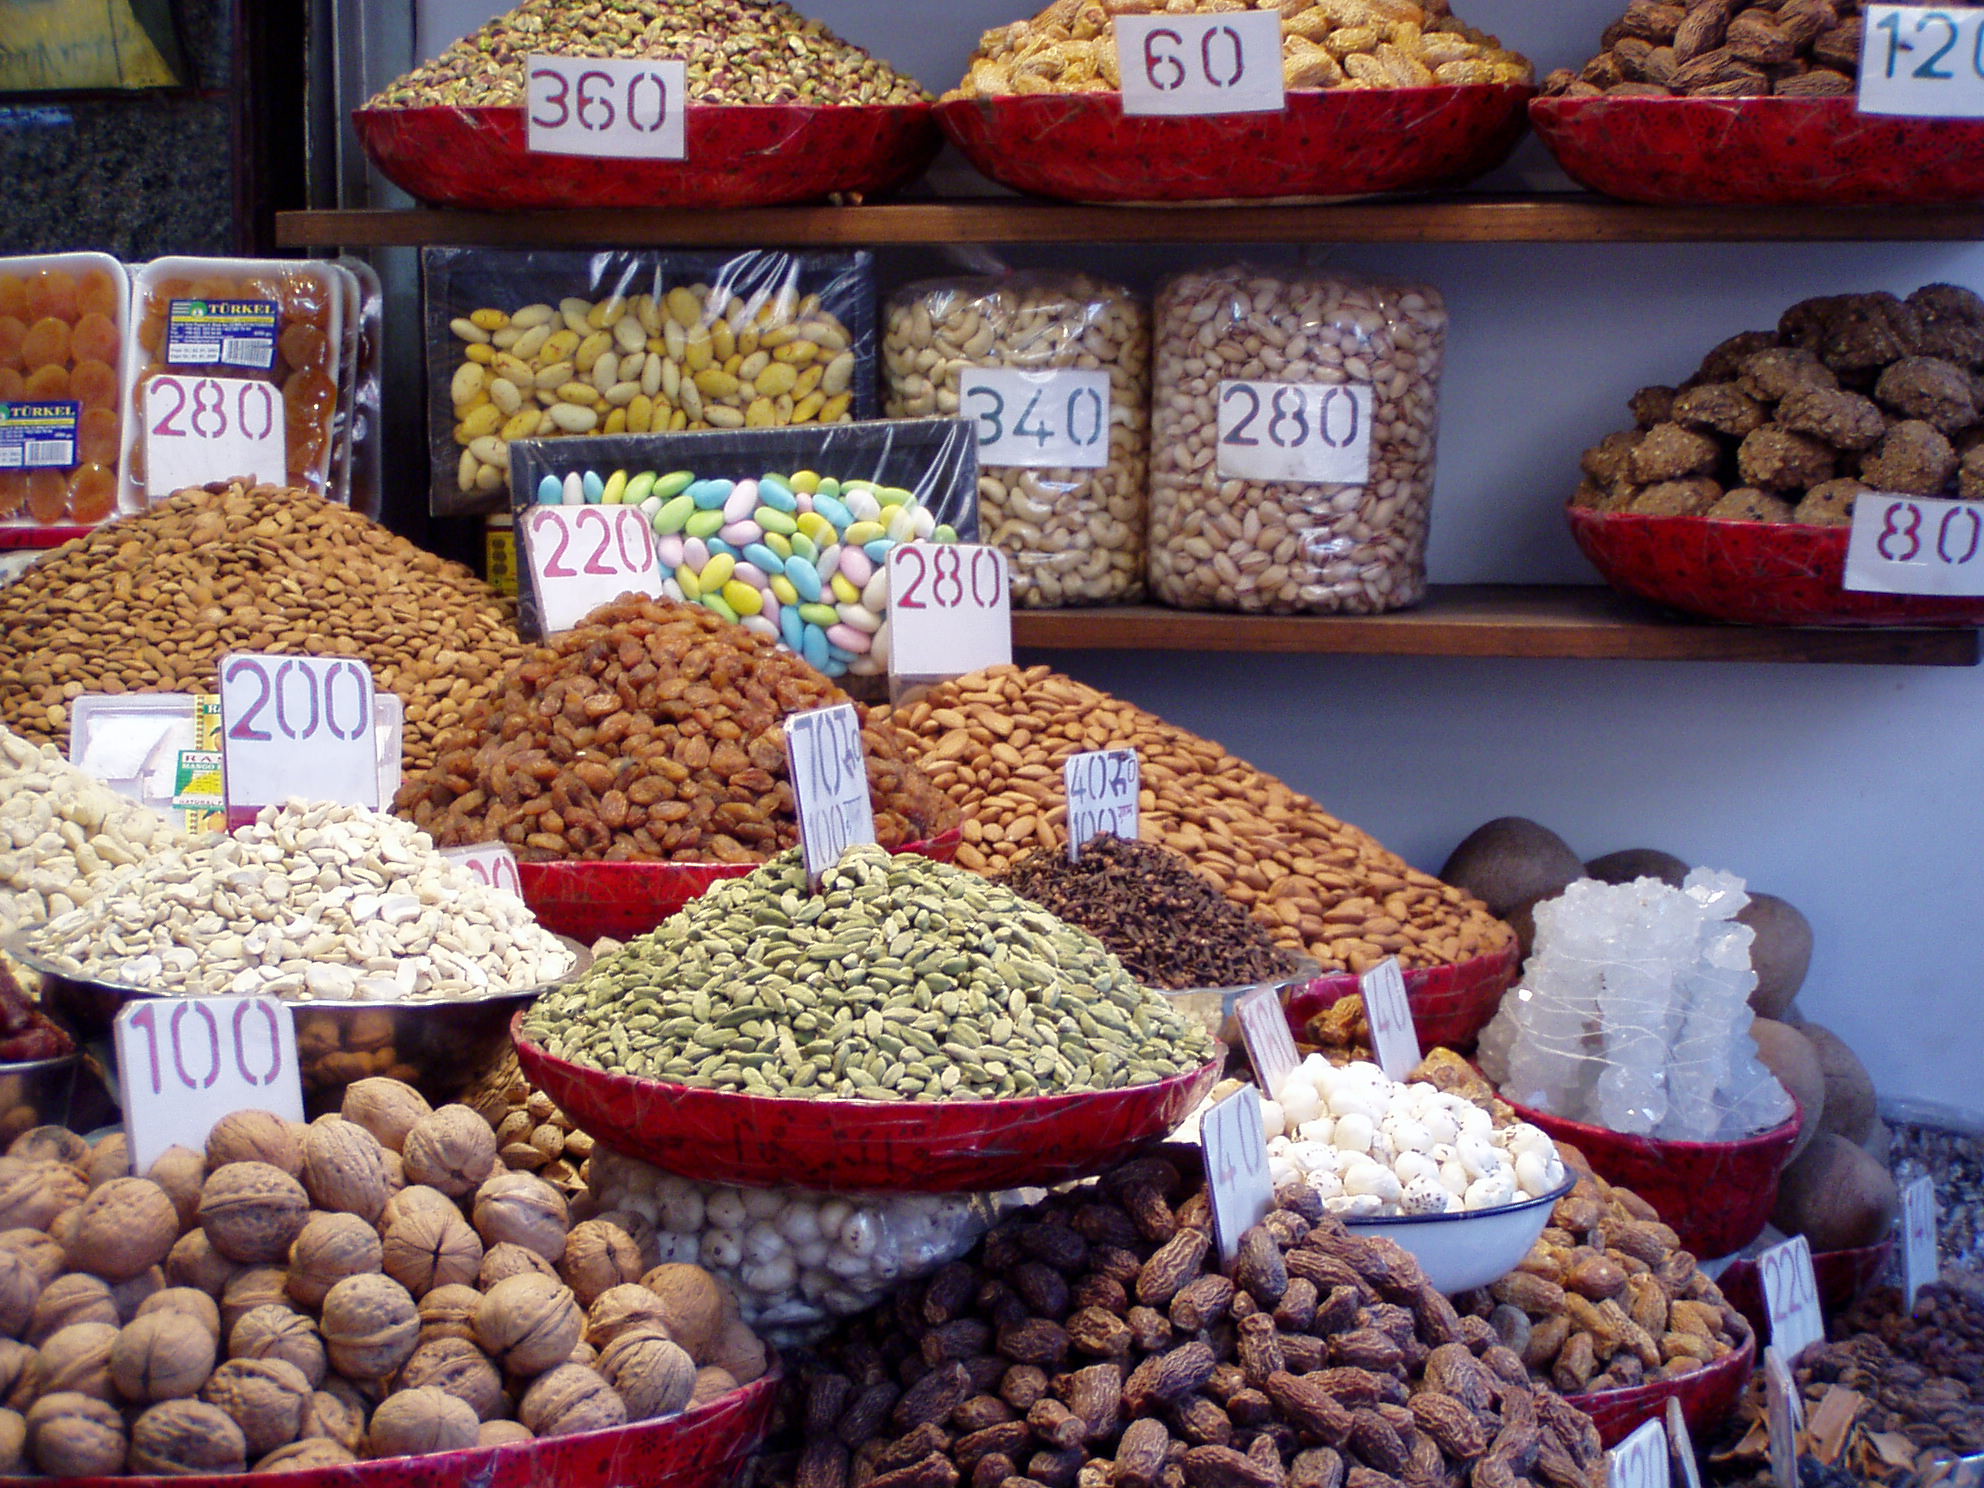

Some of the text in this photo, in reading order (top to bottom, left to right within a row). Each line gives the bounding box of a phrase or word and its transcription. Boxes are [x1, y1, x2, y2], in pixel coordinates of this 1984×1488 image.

[1144, 26, 1244, 90] 60
[1877, 11, 1984, 79] 12
[531, 69, 667, 132] 360
[208, 302, 275, 314] TÜRKEL
[10, 405, 76, 416] TÜRKEL
[150, 377, 272, 439] 280
[966, 385, 1102, 448] 340
[1222, 383, 1359, 448] 280
[533, 508, 655, 578] 220
[1877, 502, 1983, 565] 80
[895, 545, 1000, 609] 280
[226, 659, 367, 740] 200
[1070, 754, 1107, 805] 40
[1372, 965, 1406, 1039] 40
[130, 1000, 281, 1094] 100
[1217, 1091, 1260, 1191] 40
[1765, 1237, 1814, 1323] 220
